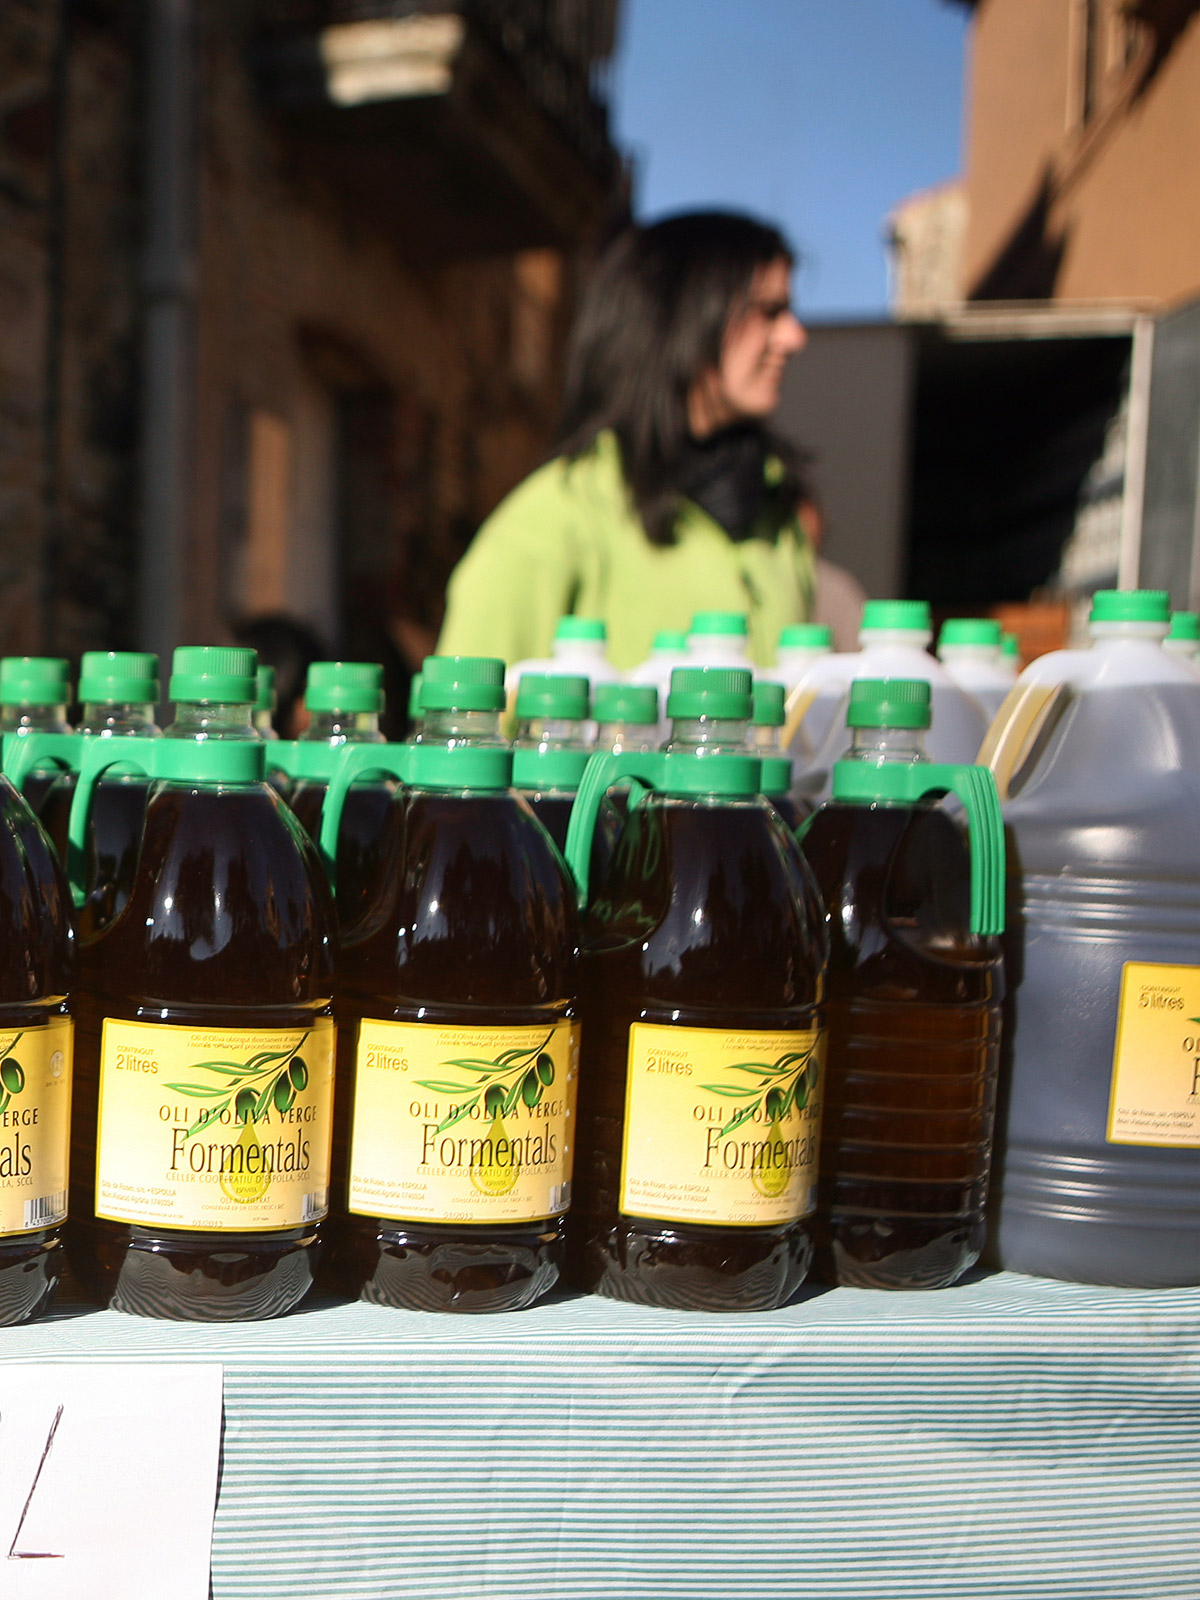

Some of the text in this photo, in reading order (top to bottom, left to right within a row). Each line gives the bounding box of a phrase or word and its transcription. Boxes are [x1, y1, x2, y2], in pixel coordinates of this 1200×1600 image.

[126, 1055, 158, 1074] litres
[376, 1054, 409, 1071] litres
[658, 1058, 693, 1076] litres
[159, 1104, 317, 1125] OLI D'OLIVA VERGE
[409, 1100, 564, 1120] OLI D'OLIVA VERGE
[693, 1105, 723, 1121] OLI
[170, 1128, 310, 1174] Formentals
[420, 1123, 558, 1167] Formentals
[17, 1177, 33, 1186] SCCL
[166, 1172, 196, 1183] CELLER
